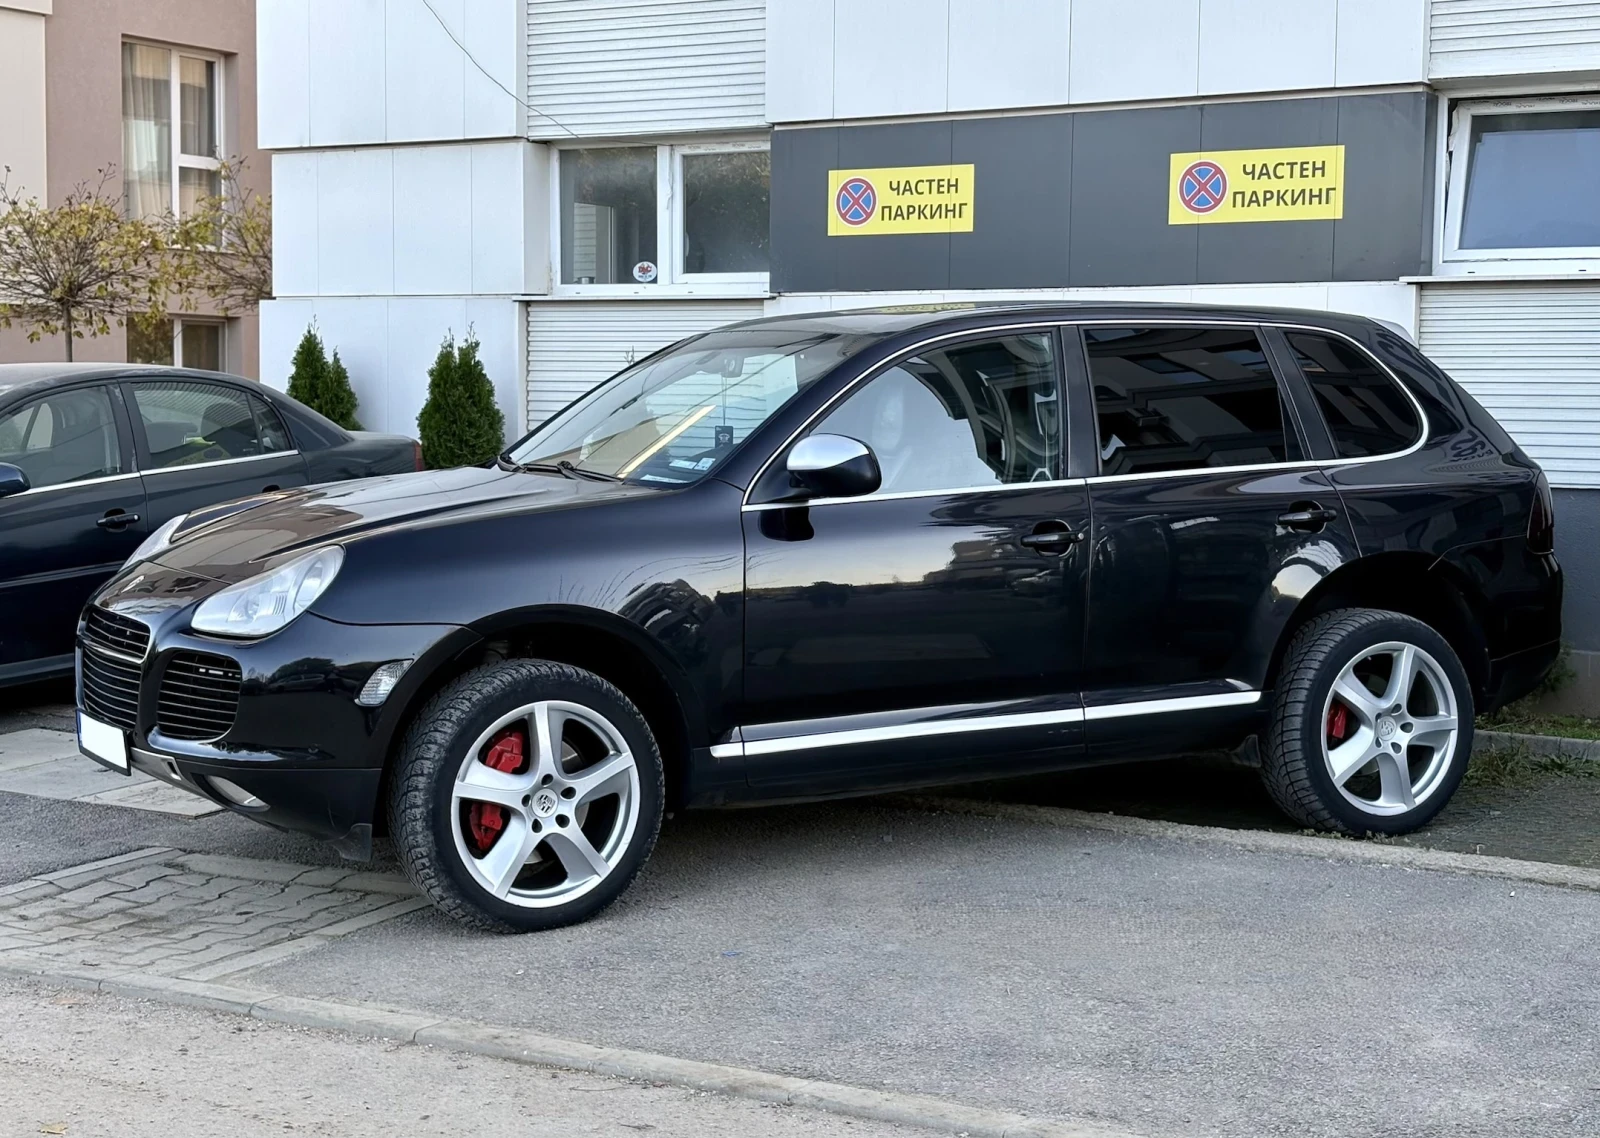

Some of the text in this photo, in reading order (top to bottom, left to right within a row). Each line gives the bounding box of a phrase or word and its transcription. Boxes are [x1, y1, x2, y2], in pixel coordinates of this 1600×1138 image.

[1242, 160, 1326, 180] ЧАСТЕН
[889, 178, 959, 196] ЧАСТЕН
[1232, 187, 1336, 208] ПАРКИНГ
[880, 203, 968, 221] ПАРКИНГ
